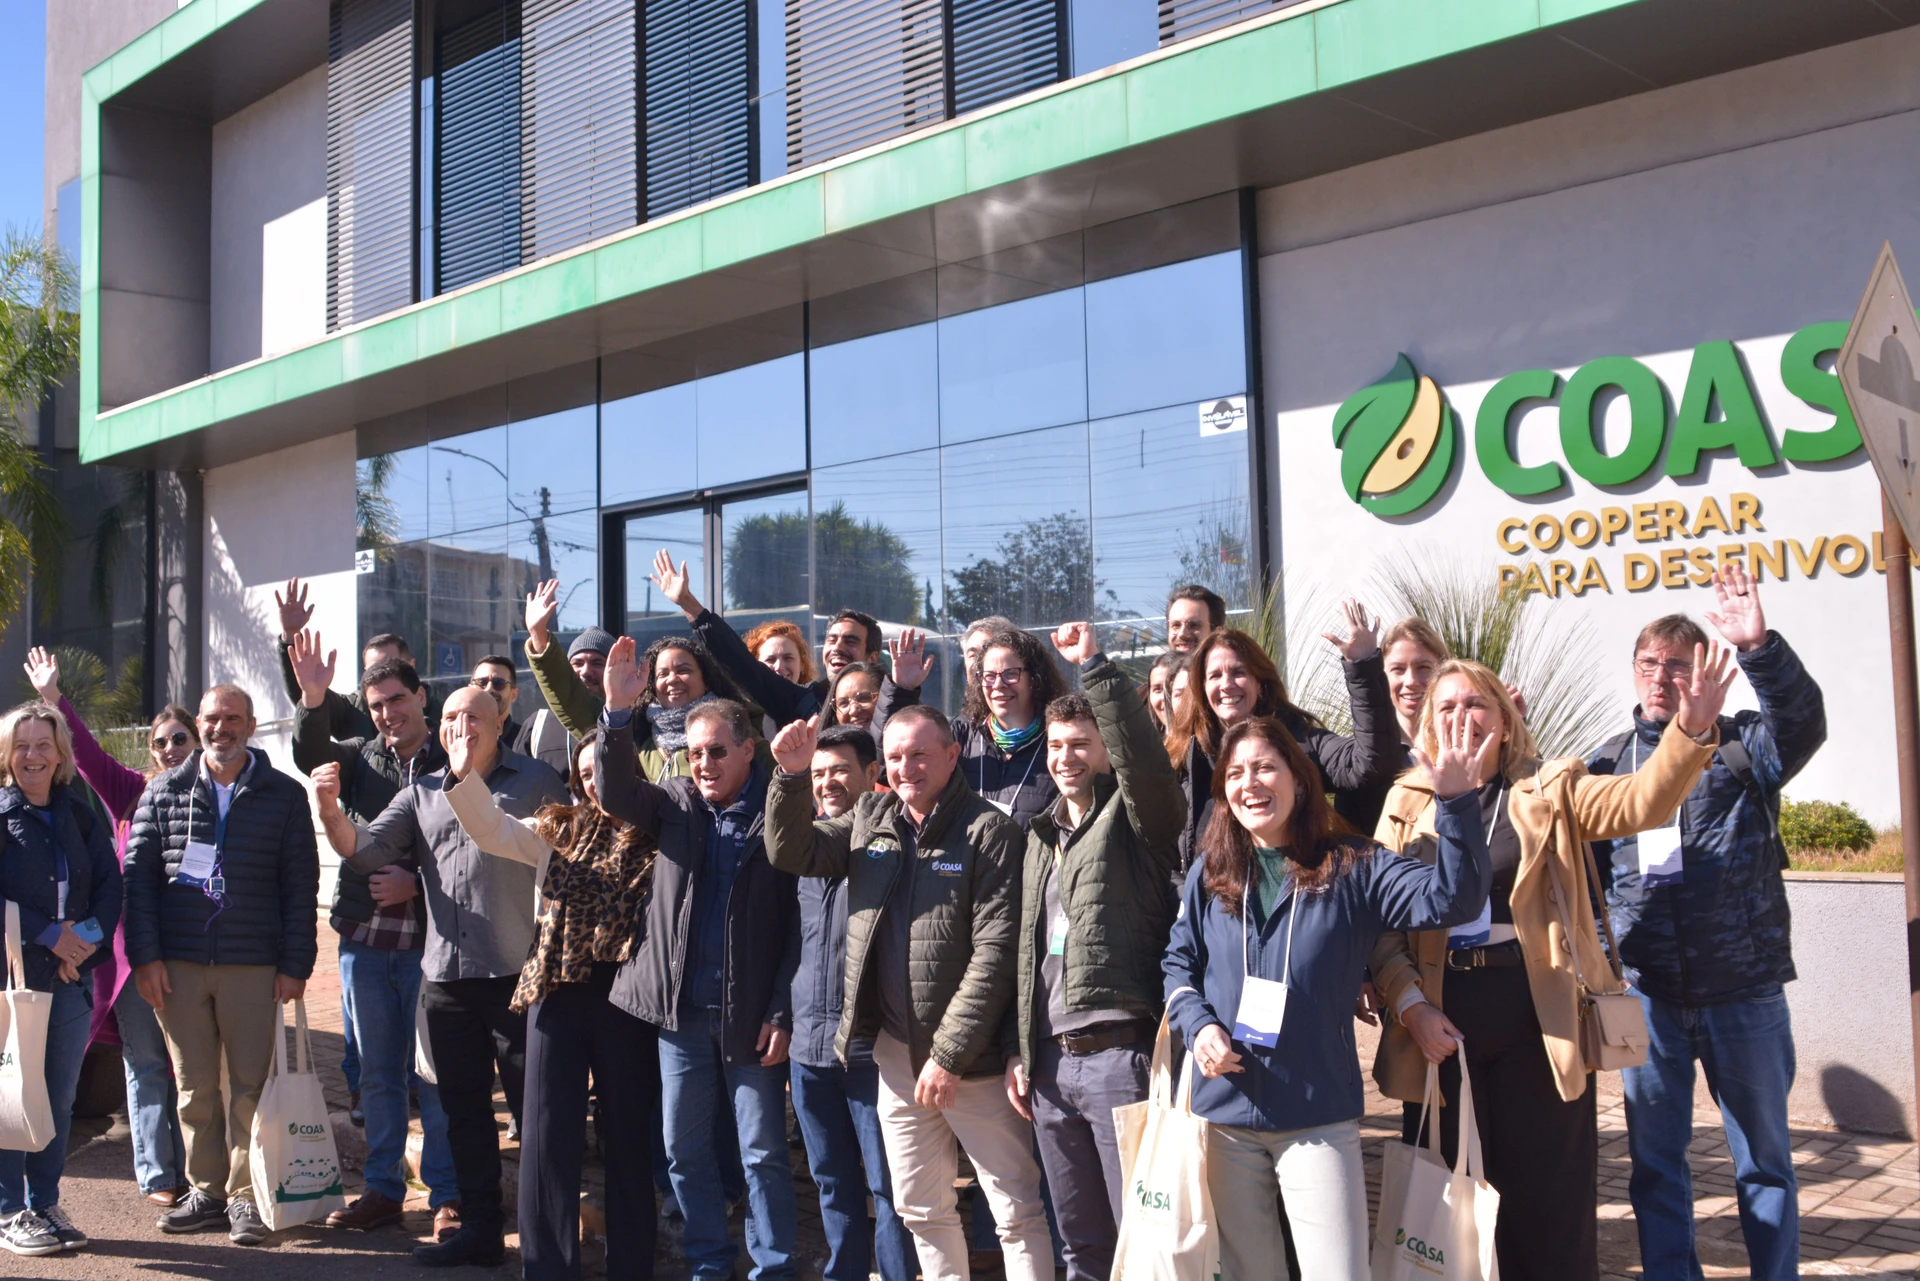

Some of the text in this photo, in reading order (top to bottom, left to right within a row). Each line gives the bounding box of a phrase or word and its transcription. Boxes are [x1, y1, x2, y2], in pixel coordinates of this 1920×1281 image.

[1475, 308, 1920, 496] COAS
[1496, 492, 1762, 553] COOPERAR
[1498, 531, 1920, 597] PARA DESENVOL
[940, 863, 962, 871] COASA
